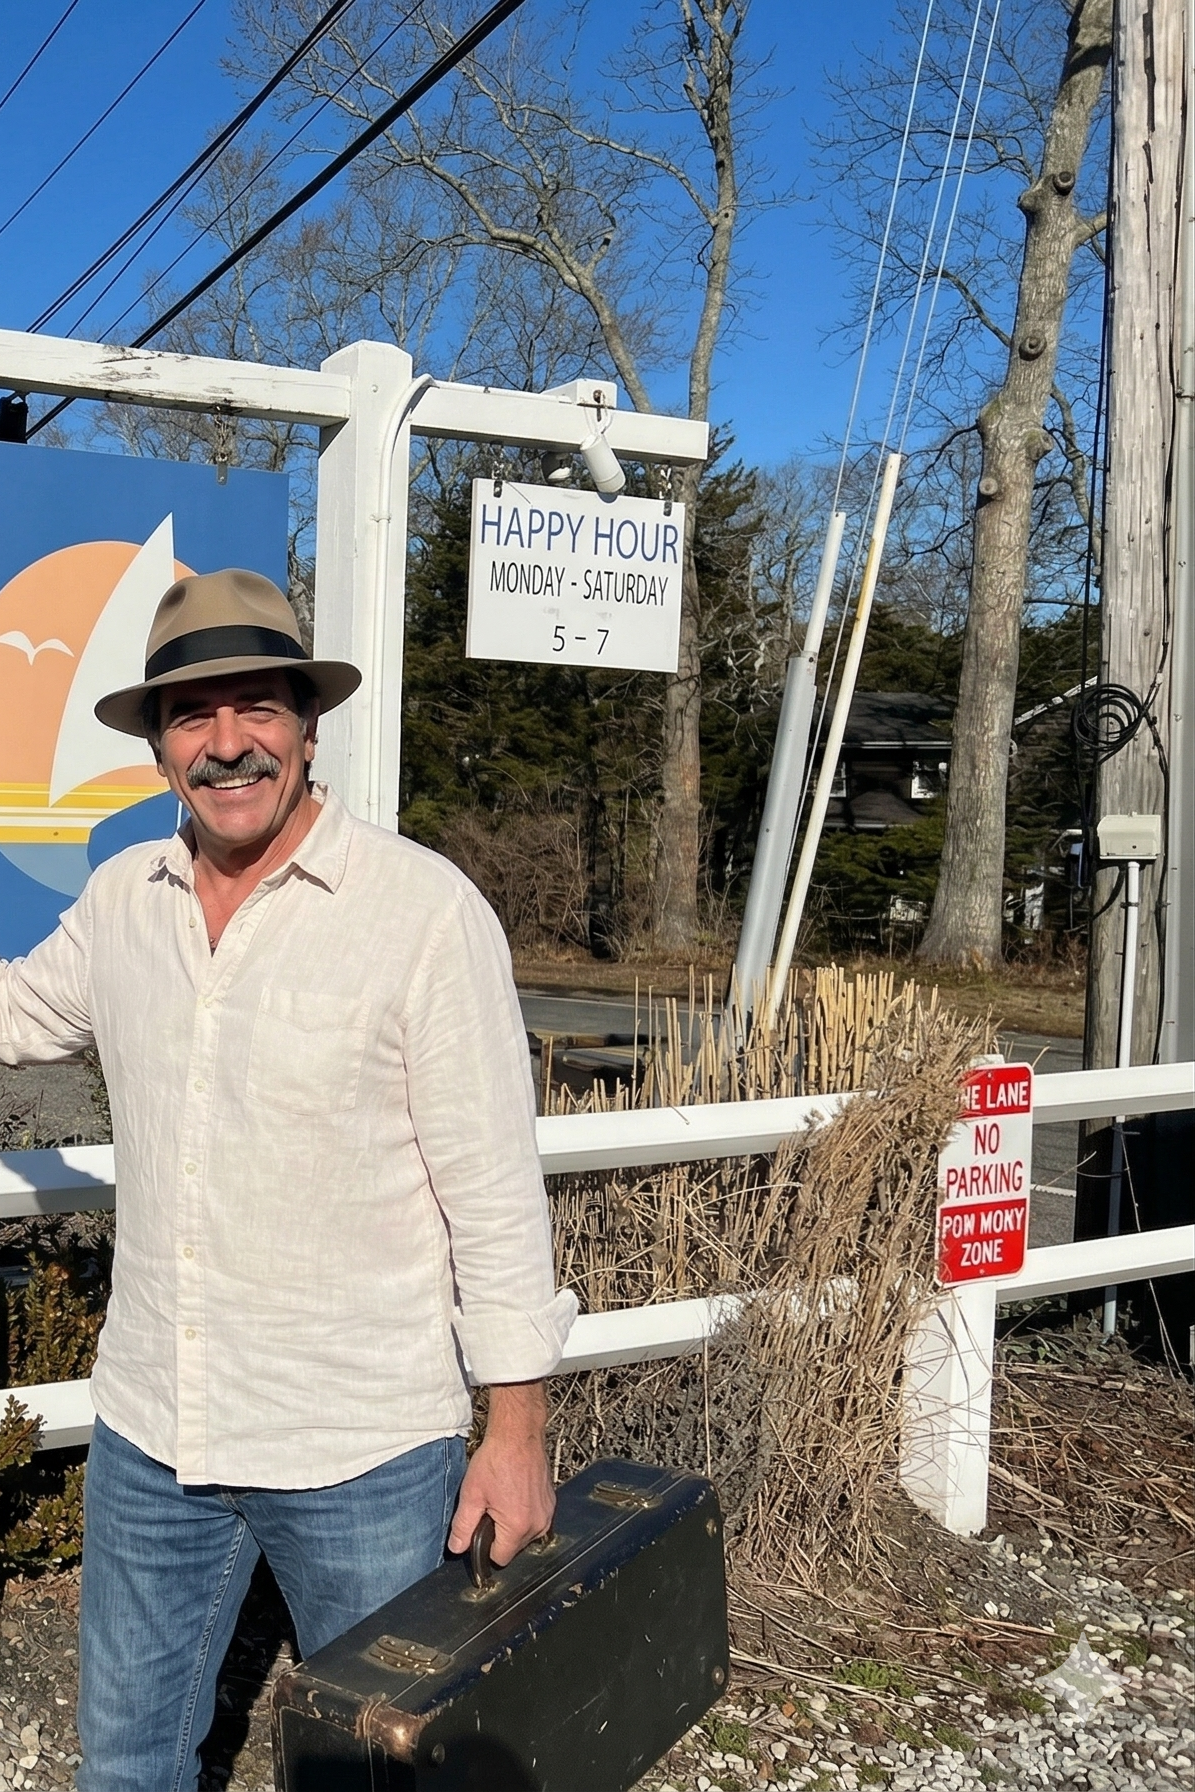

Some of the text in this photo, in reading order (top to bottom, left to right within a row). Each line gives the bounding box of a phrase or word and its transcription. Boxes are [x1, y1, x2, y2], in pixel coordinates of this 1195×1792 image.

[481, 503, 678, 564] HAPPY HOUR
[490, 560, 566, 597] MONDAY
[582, 568, 669, 606] SATURDAY
[552, 625, 566, 652] 5
[597, 628, 610, 655] 7
[986, 1081, 1029, 1109] LANE
[974, 1122, 1001, 1156] NO
[946, 1160, 1023, 1199] PARKING
[960, 1238, 1004, 1267] ZONE
